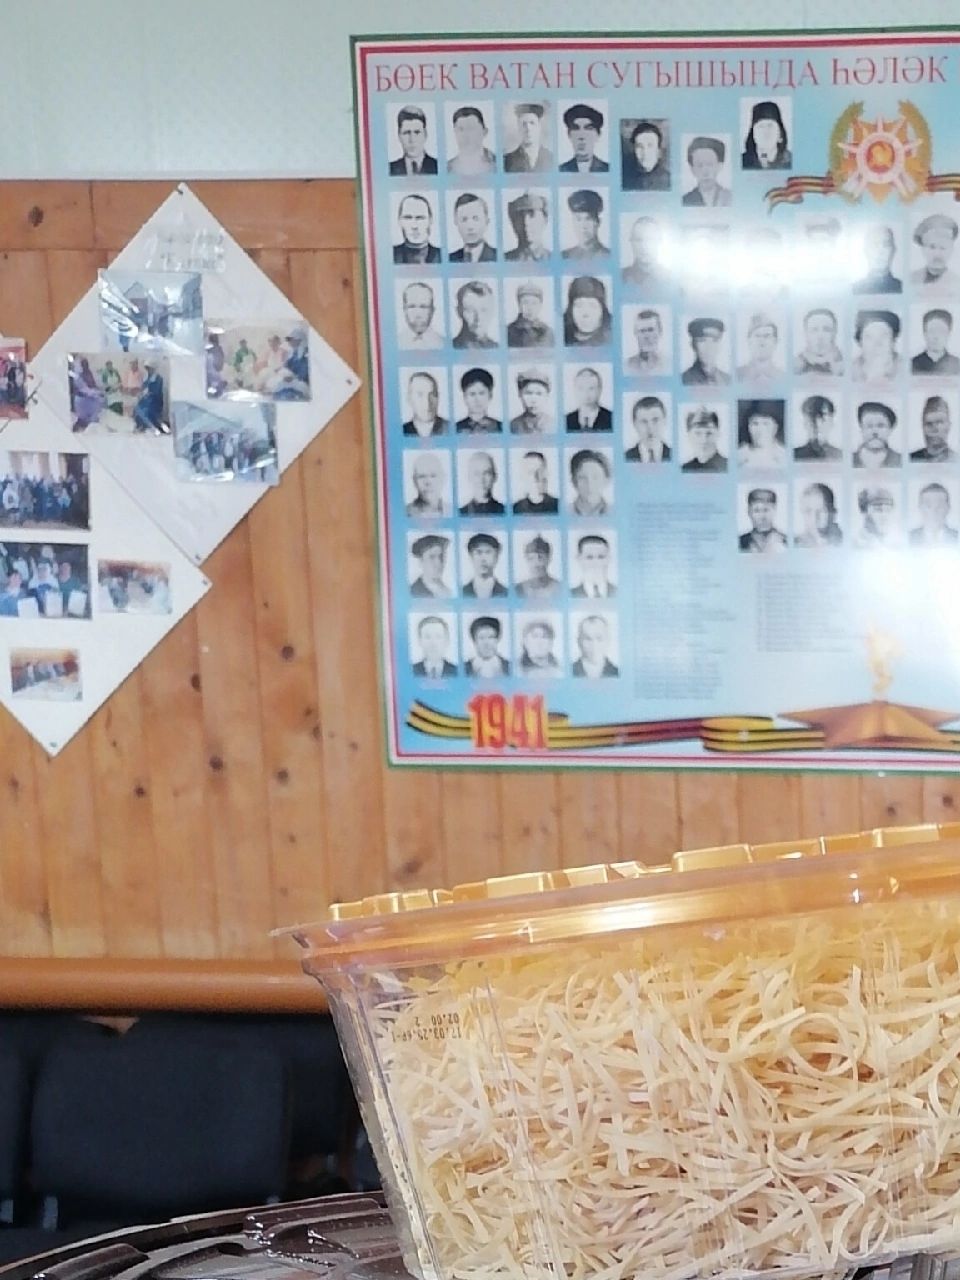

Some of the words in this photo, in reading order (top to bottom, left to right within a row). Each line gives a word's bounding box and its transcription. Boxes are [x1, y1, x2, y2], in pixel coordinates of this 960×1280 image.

[375, 63, 458, 92] БӨЕК
[469, 61, 575, 90] ВАТАН
[587, 58, 819, 89] СУГЫШЫНДА
[831, 55, 948, 86] ҺӘЛӘК
[469, 694, 547, 748] 1941
